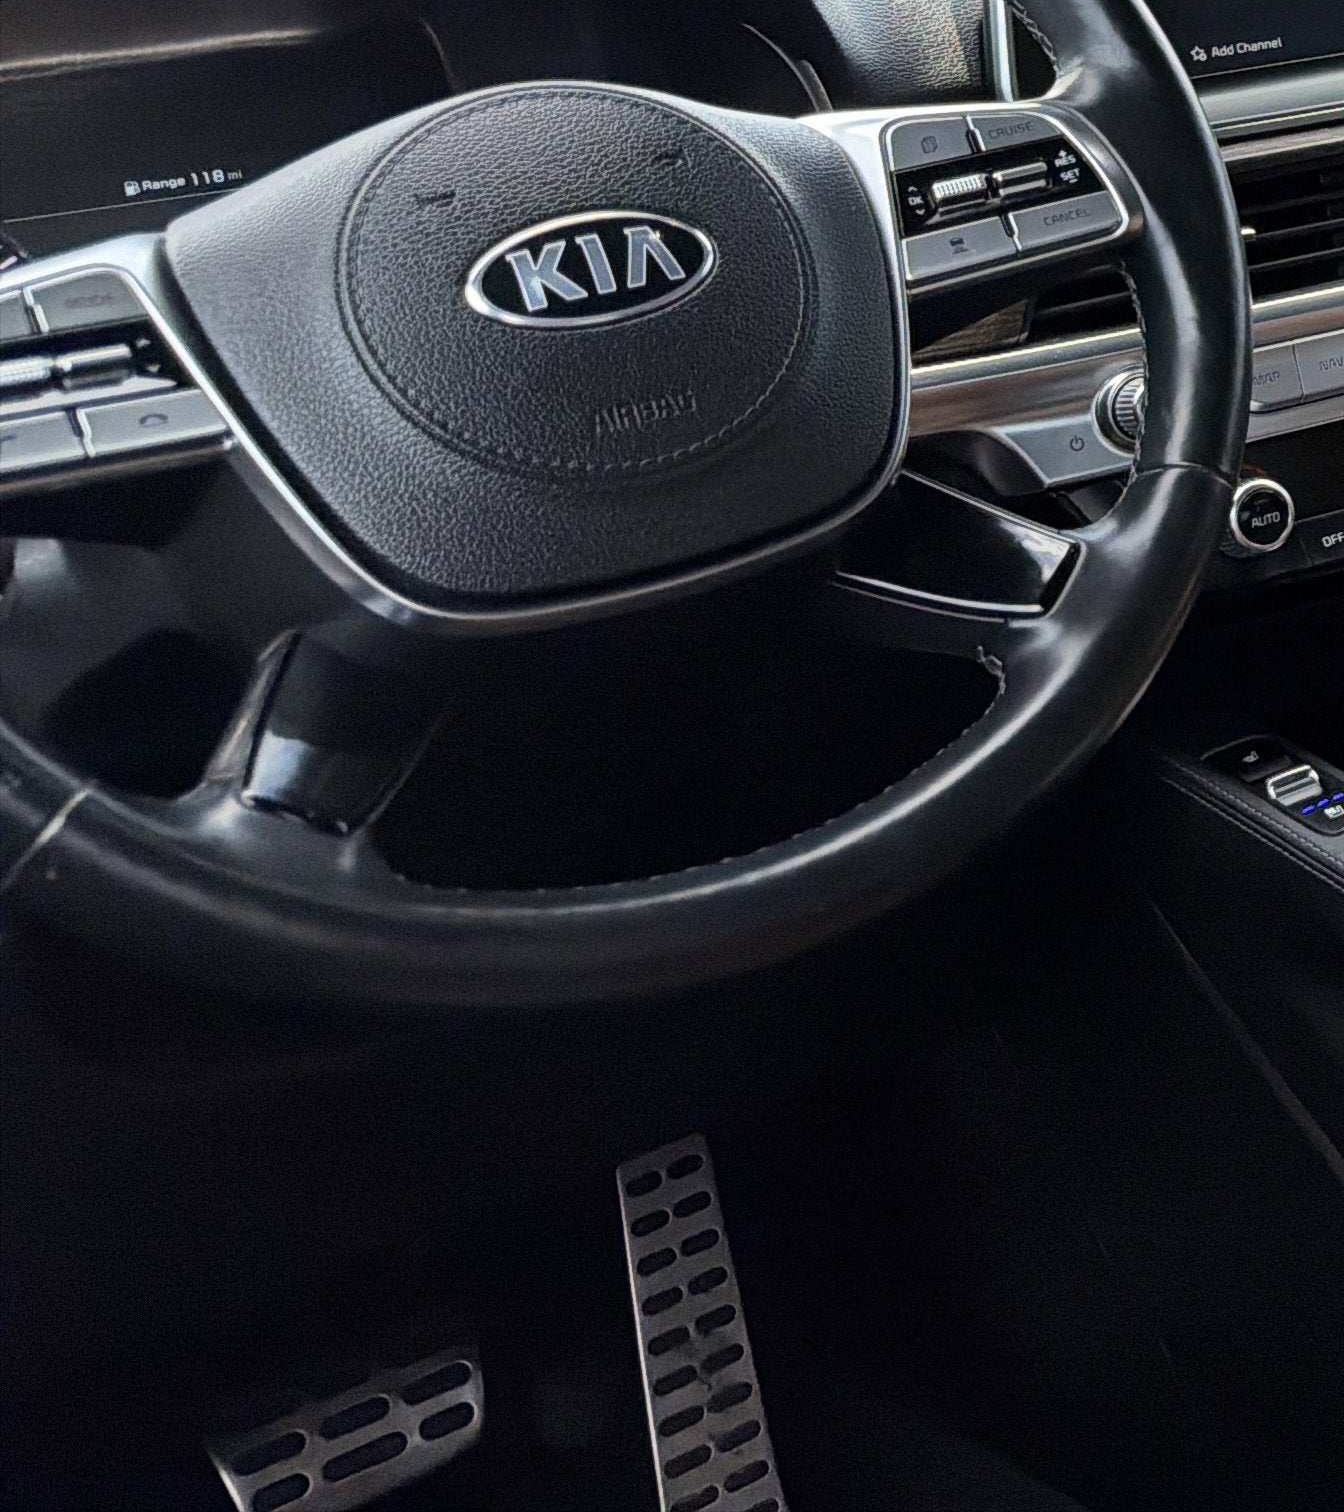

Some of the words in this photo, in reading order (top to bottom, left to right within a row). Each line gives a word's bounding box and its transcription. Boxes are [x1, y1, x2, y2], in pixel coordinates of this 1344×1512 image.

[1211, 45, 1235, 57] Add
[1236, 37, 1282, 54] Channel
[988, 122, 1033, 139] CRUISE
[1054, 155, 1077, 168] RES
[141, 177, 186, 191] Range
[191, 169, 225, 186] 118
[227, 170, 243, 181] mi
[1059, 168, 1081, 181] SET
[908, 196, 924, 207] OK
[1043, 208, 1092, 227] CANCEL
[505, 225, 686, 312] KIA
[1319, 356, 1344, 372] NAV
[1252, 370, 1281, 387] MAP
[1251, 511, 1281, 529] AUTO
